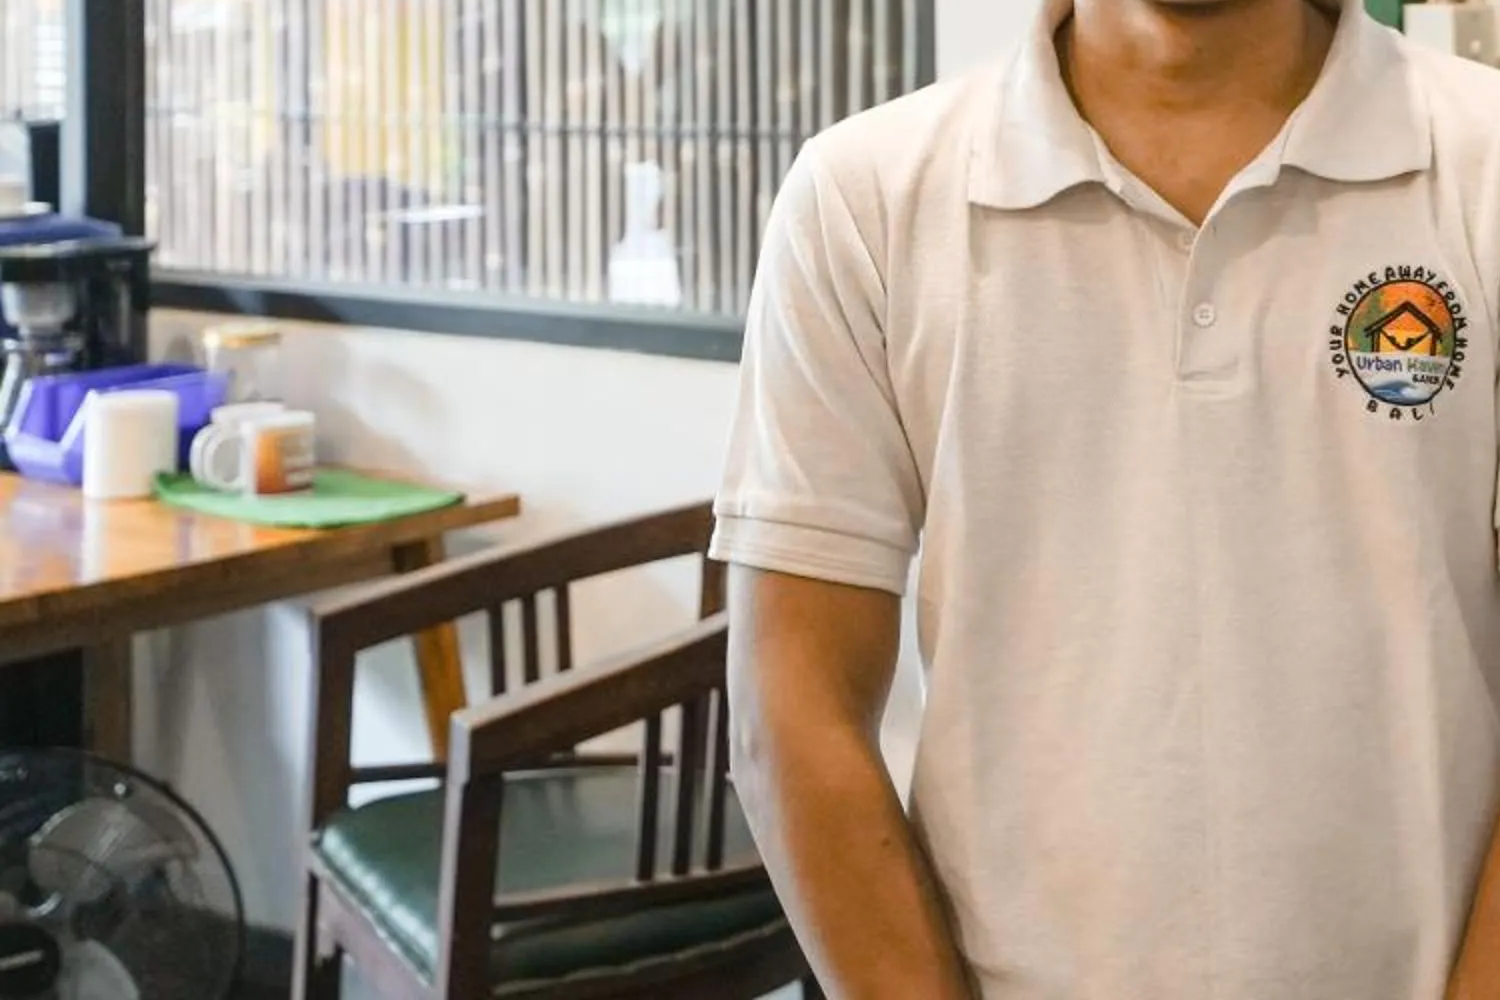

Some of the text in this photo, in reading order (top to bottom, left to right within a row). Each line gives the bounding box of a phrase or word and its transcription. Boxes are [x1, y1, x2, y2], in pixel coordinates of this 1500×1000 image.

[1384, 265, 1437, 282] AWAY
[1336, 272, 1381, 316] HOME
[1436, 281, 1467, 331] FROM
[1329, 325, 1350, 379] YOUR
[1356, 356, 1403, 373] Urban
[1366, 399, 1435, 420] BALI
